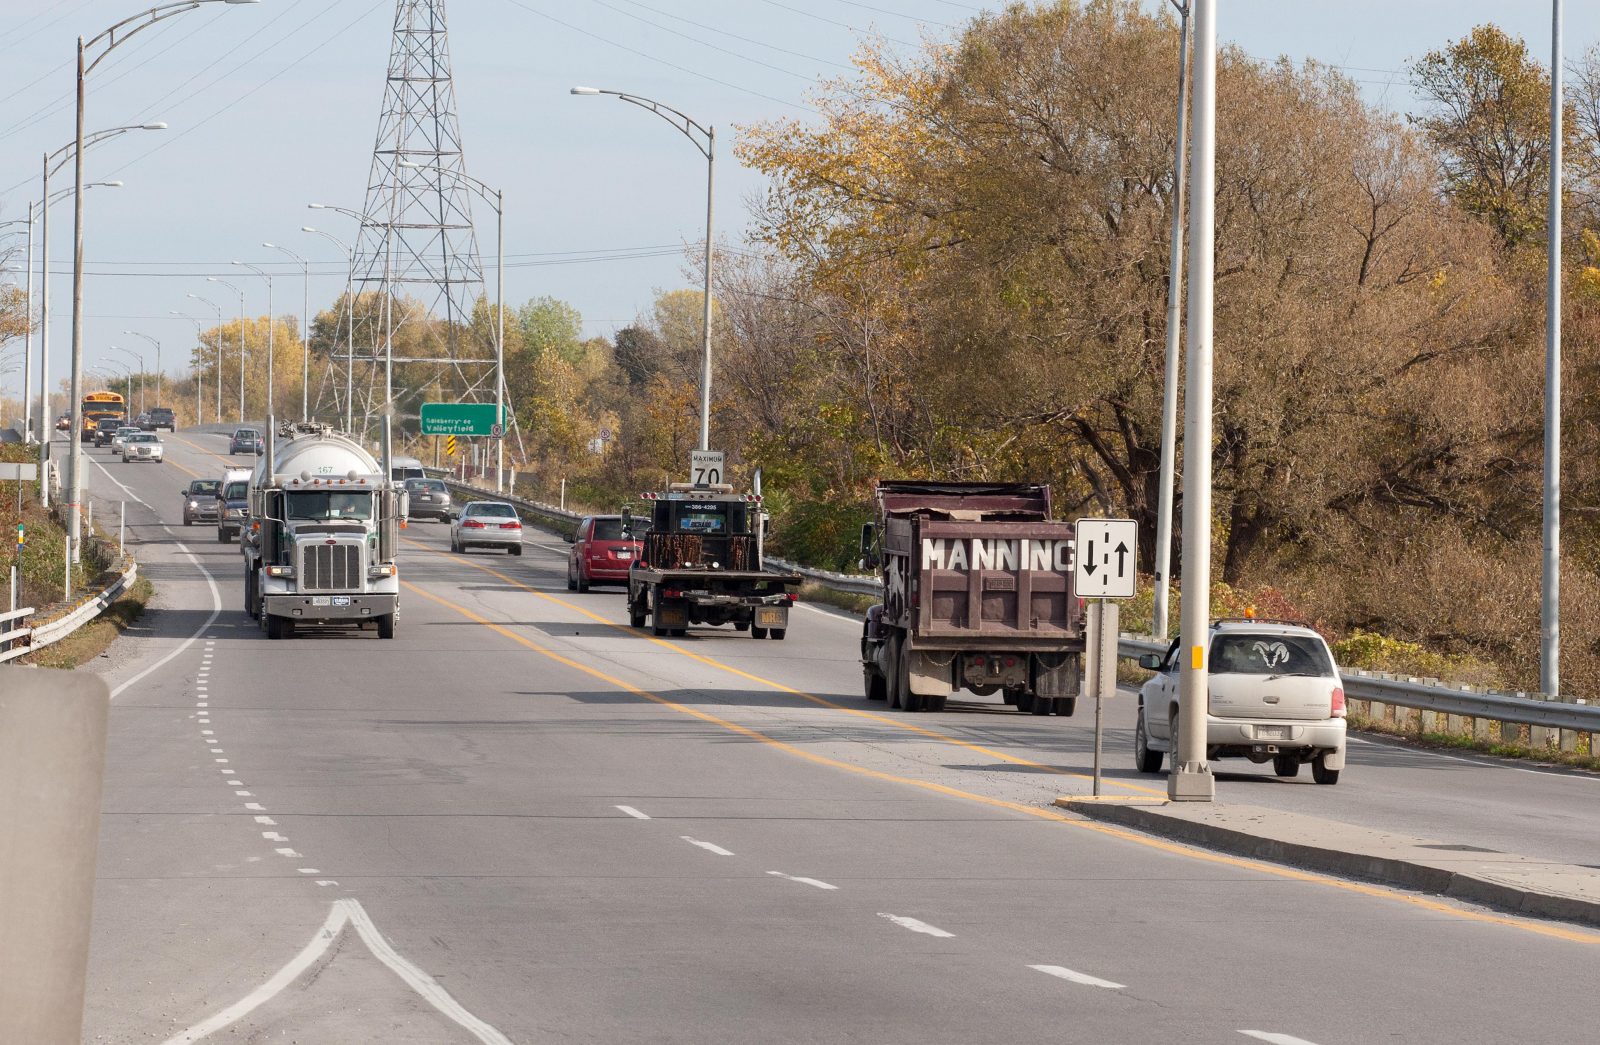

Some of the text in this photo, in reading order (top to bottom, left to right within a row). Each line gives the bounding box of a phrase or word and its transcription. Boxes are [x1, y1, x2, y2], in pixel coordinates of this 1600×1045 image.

[426, 425, 474, 434] Valleyfield
[318, 466, 333, 474] 167
[695, 468, 719, 484] 70
[922, 539, 1075, 571] MANNING
